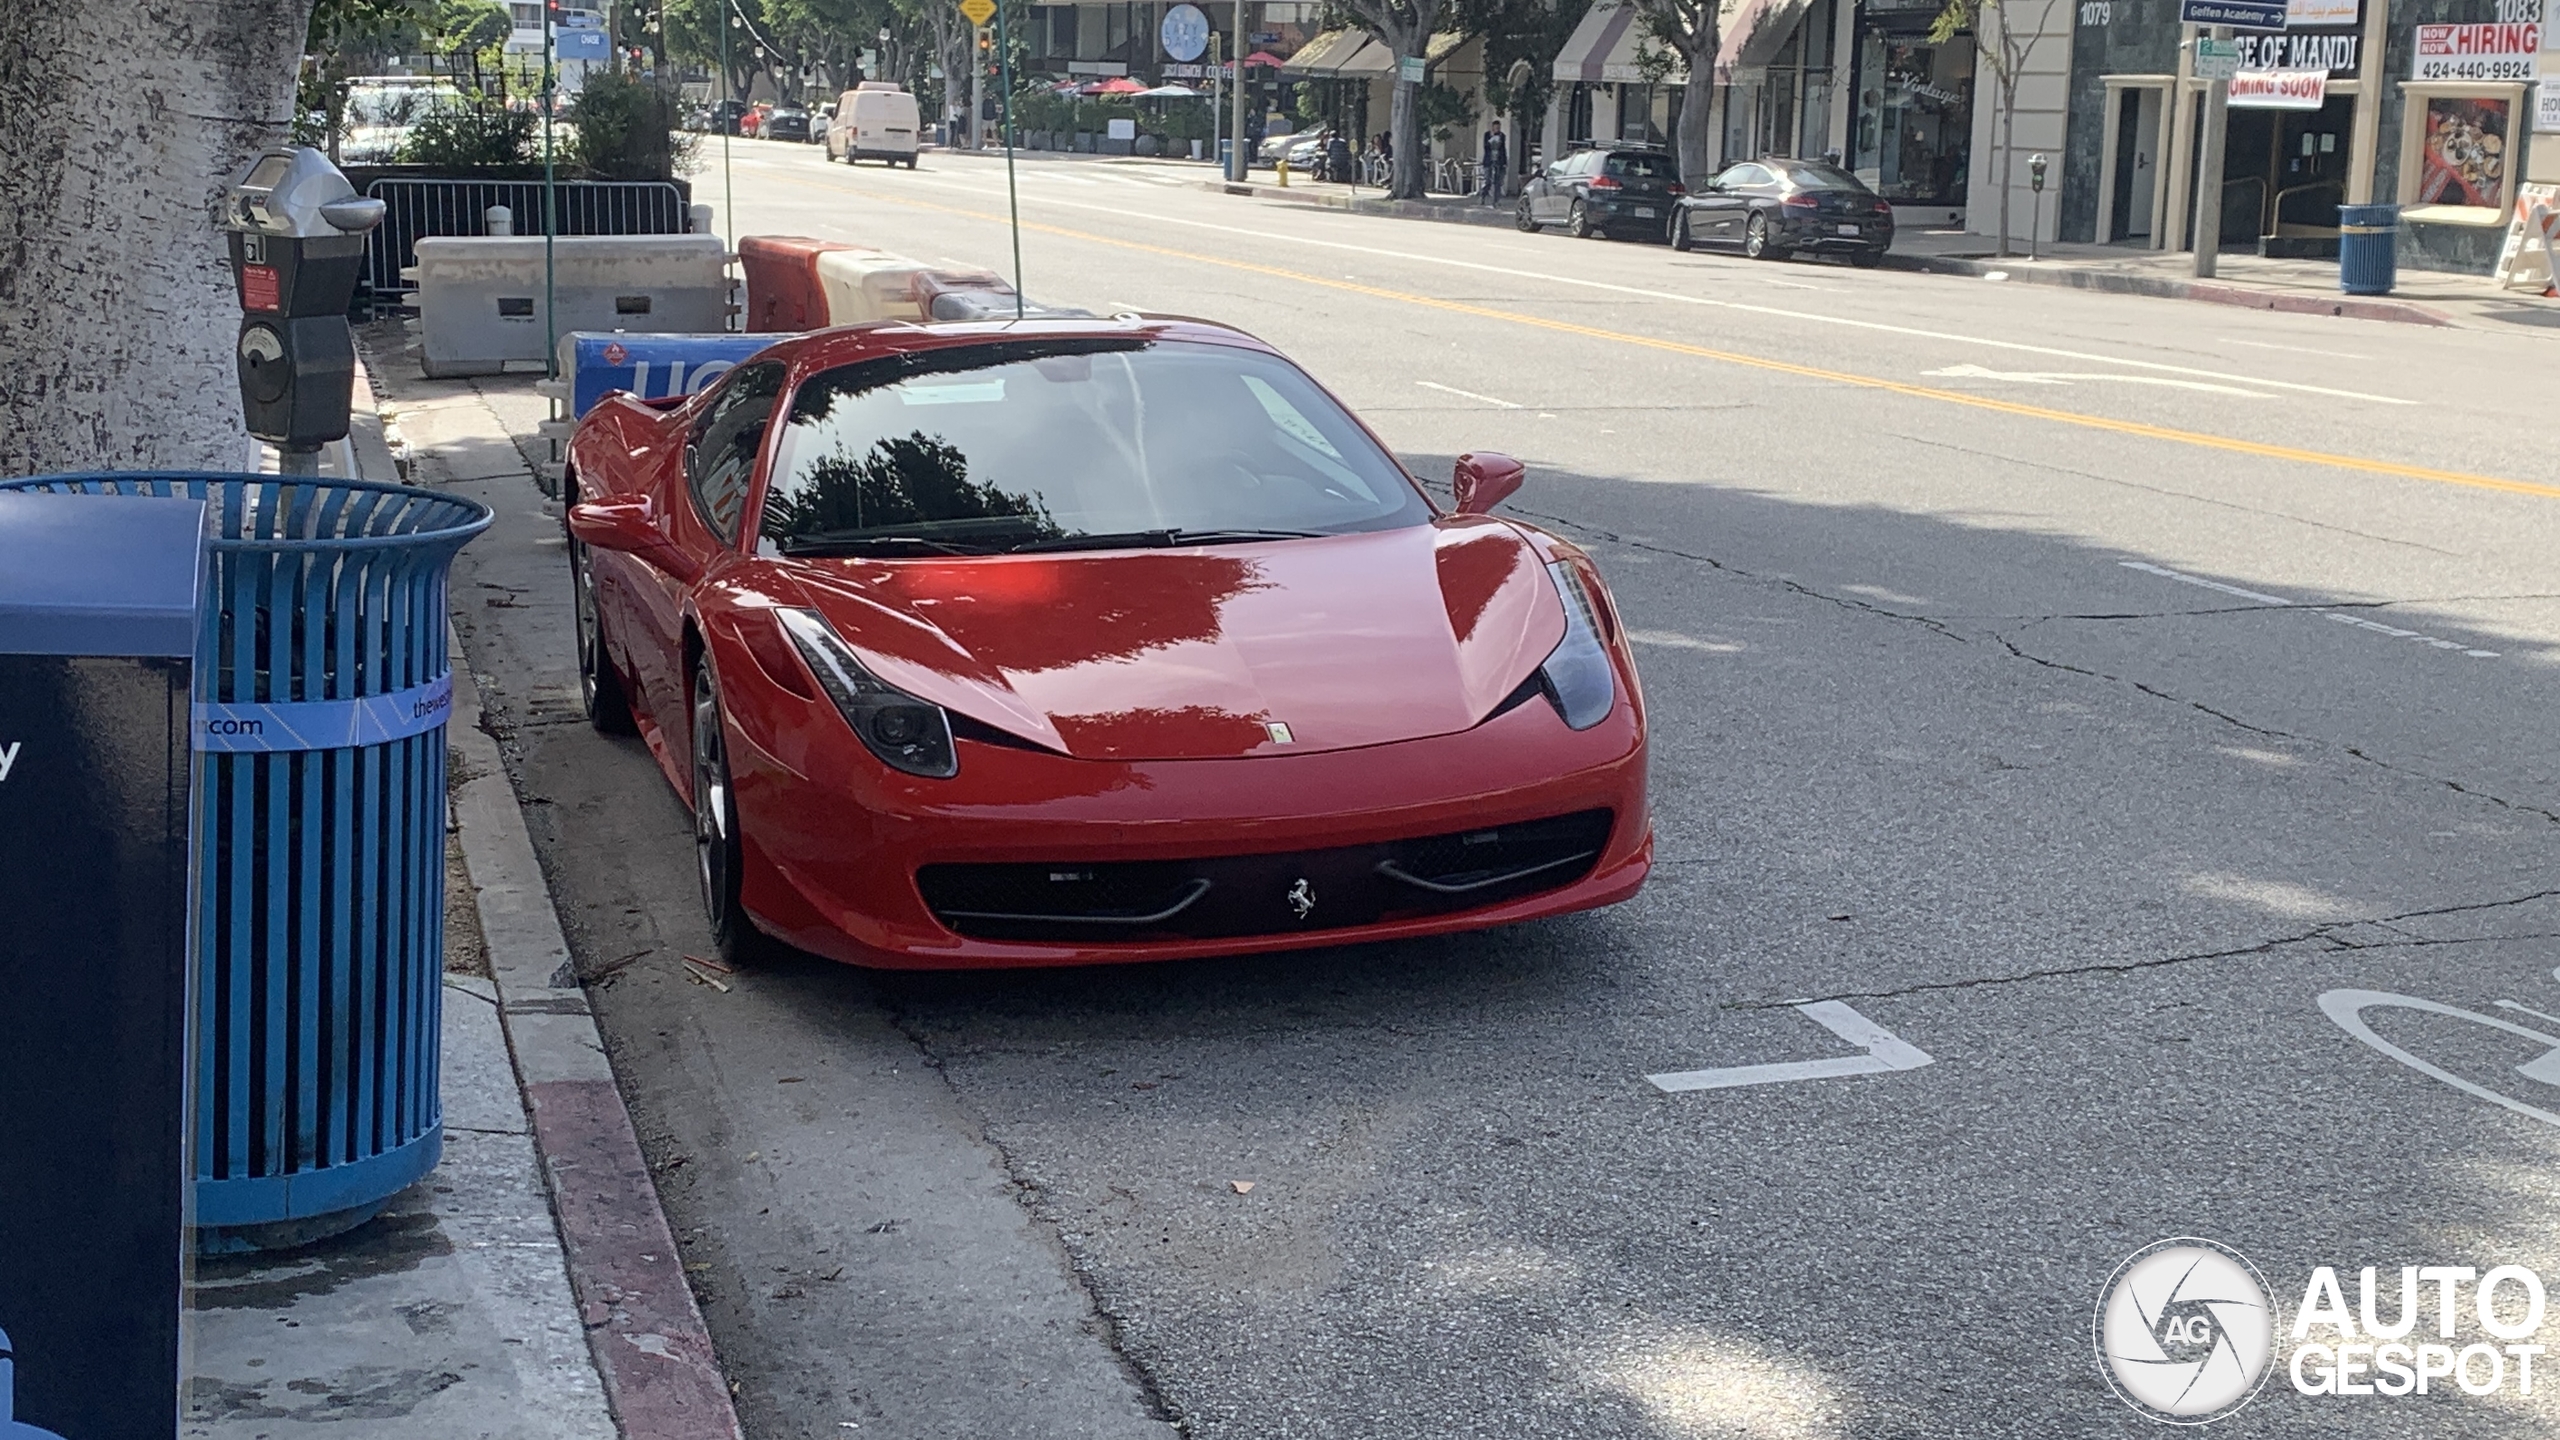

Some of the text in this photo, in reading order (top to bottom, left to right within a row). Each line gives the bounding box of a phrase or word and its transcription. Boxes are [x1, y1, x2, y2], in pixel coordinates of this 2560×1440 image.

[2081, 2, 2111, 25] 1079
[2190, 5, 2266, 23] Geffen Academy
[2495, 0, 2540, 23] 1083
[581, 34, 600, 45] CHASE
[1164, 23, 1199, 36] LAZY
[2422, 24, 2538, 54] NOW HIRING
[2261, 36, 2287, 68] OF
[2290, 35, 2357, 69] MANDI
[2421, 42, 2447, 53] NOW
[1901, 71, 1960, 104] Vintage
[2228, 76, 2322, 100] OMING SOON
[2541, 97, 2560, 112] HO
